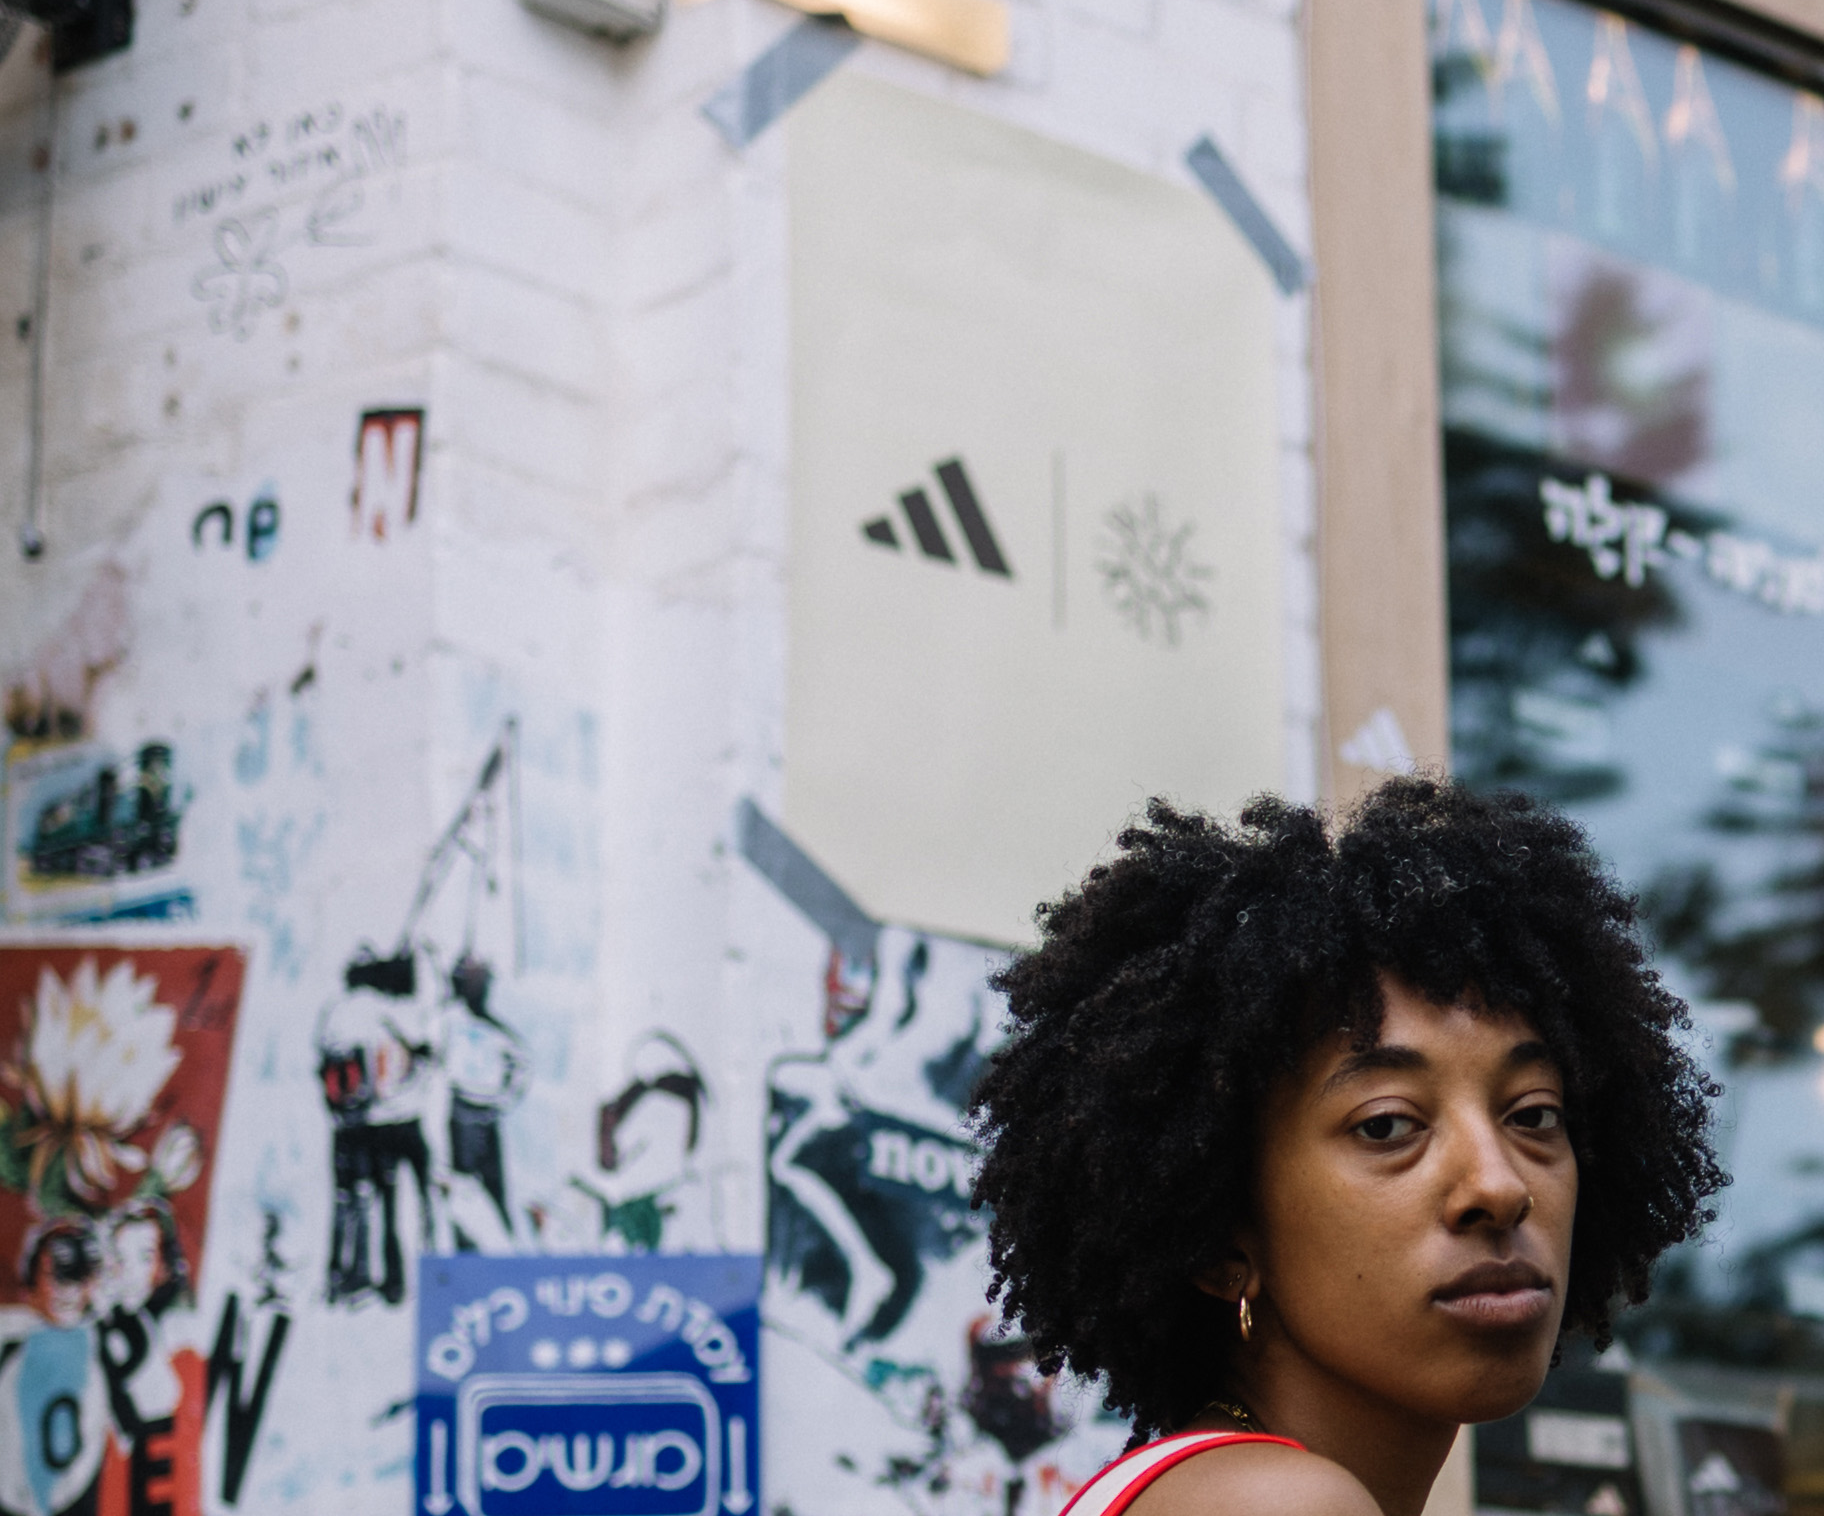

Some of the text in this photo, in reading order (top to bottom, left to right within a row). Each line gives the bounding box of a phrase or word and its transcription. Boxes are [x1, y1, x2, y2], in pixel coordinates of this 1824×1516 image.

[427, 1286, 530, 1381] כלים
[634, 1283, 751, 1383] עמדת
[481, 1429, 702, 1492] מגשים
